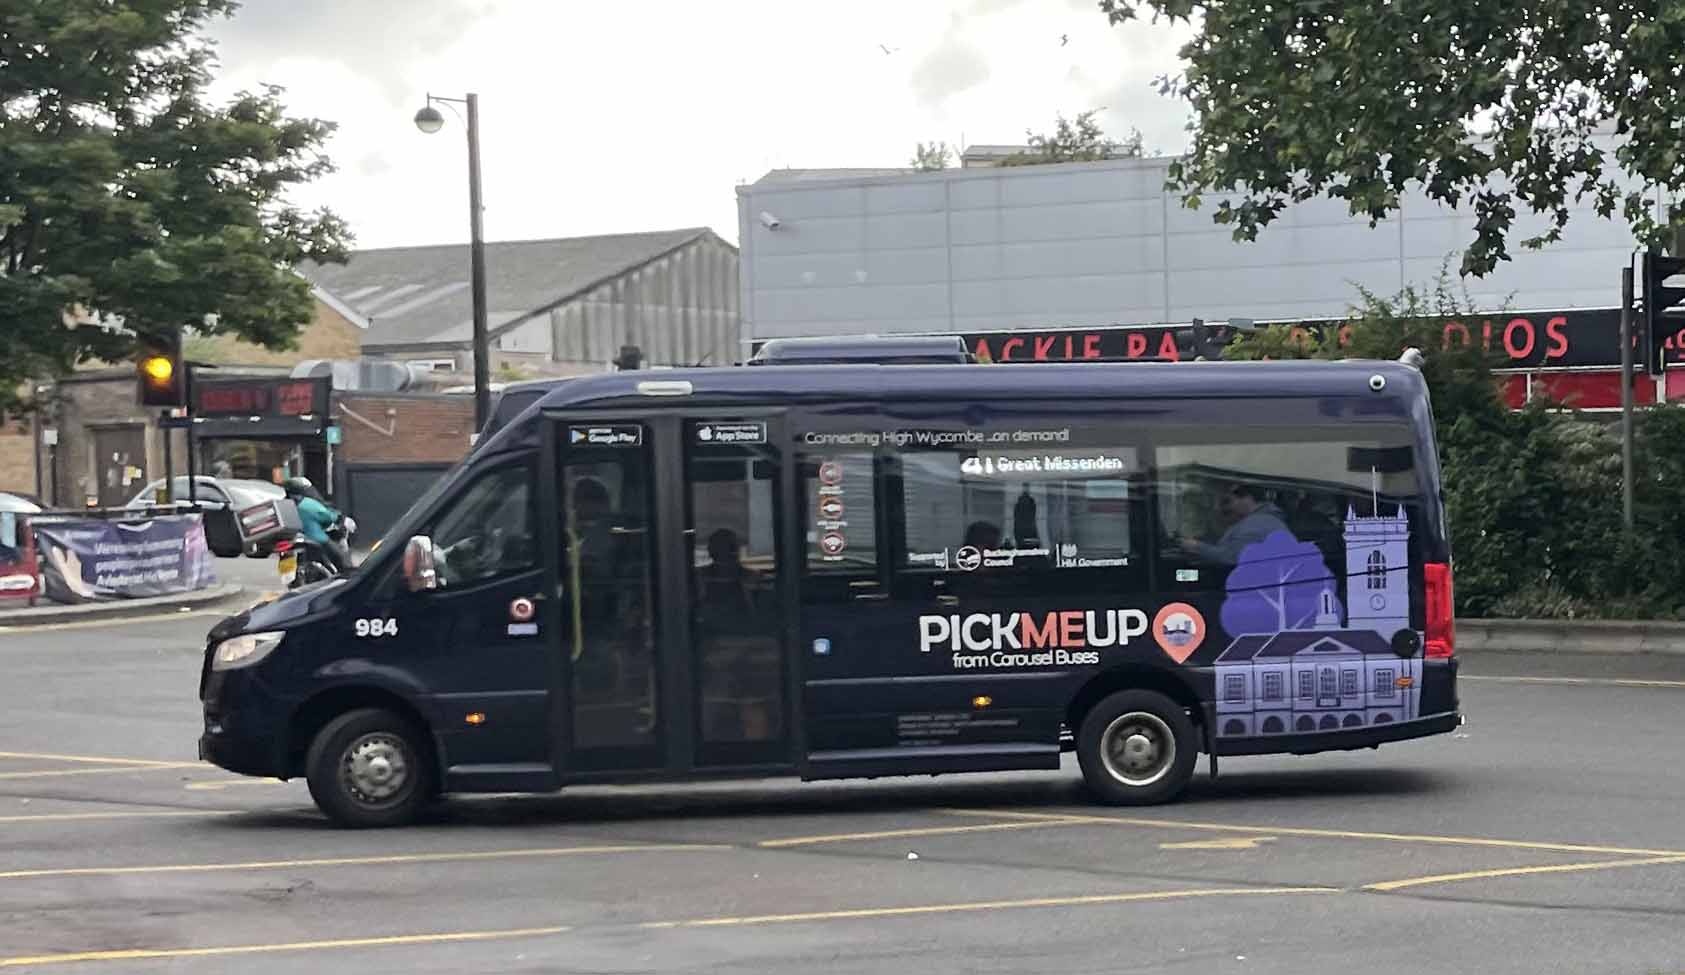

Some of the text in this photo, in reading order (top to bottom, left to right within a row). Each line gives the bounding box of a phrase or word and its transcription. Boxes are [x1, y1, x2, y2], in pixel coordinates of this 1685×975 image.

[975, 334, 1101, 363] ACKIE
[716, 431, 759, 441] App Store
[804, 431, 879, 446] Connecting
[882, 431, 913, 446] High
[916, 431, 984, 446] Wycombe
[997, 456, 1042, 472] Great
[1043, 455, 1123, 472] Missenden
[355, 618, 398, 636] 984
[919, 609, 1148, 652] PICKMEUP
[953, 649, 1099, 668] from Carousel Buses
